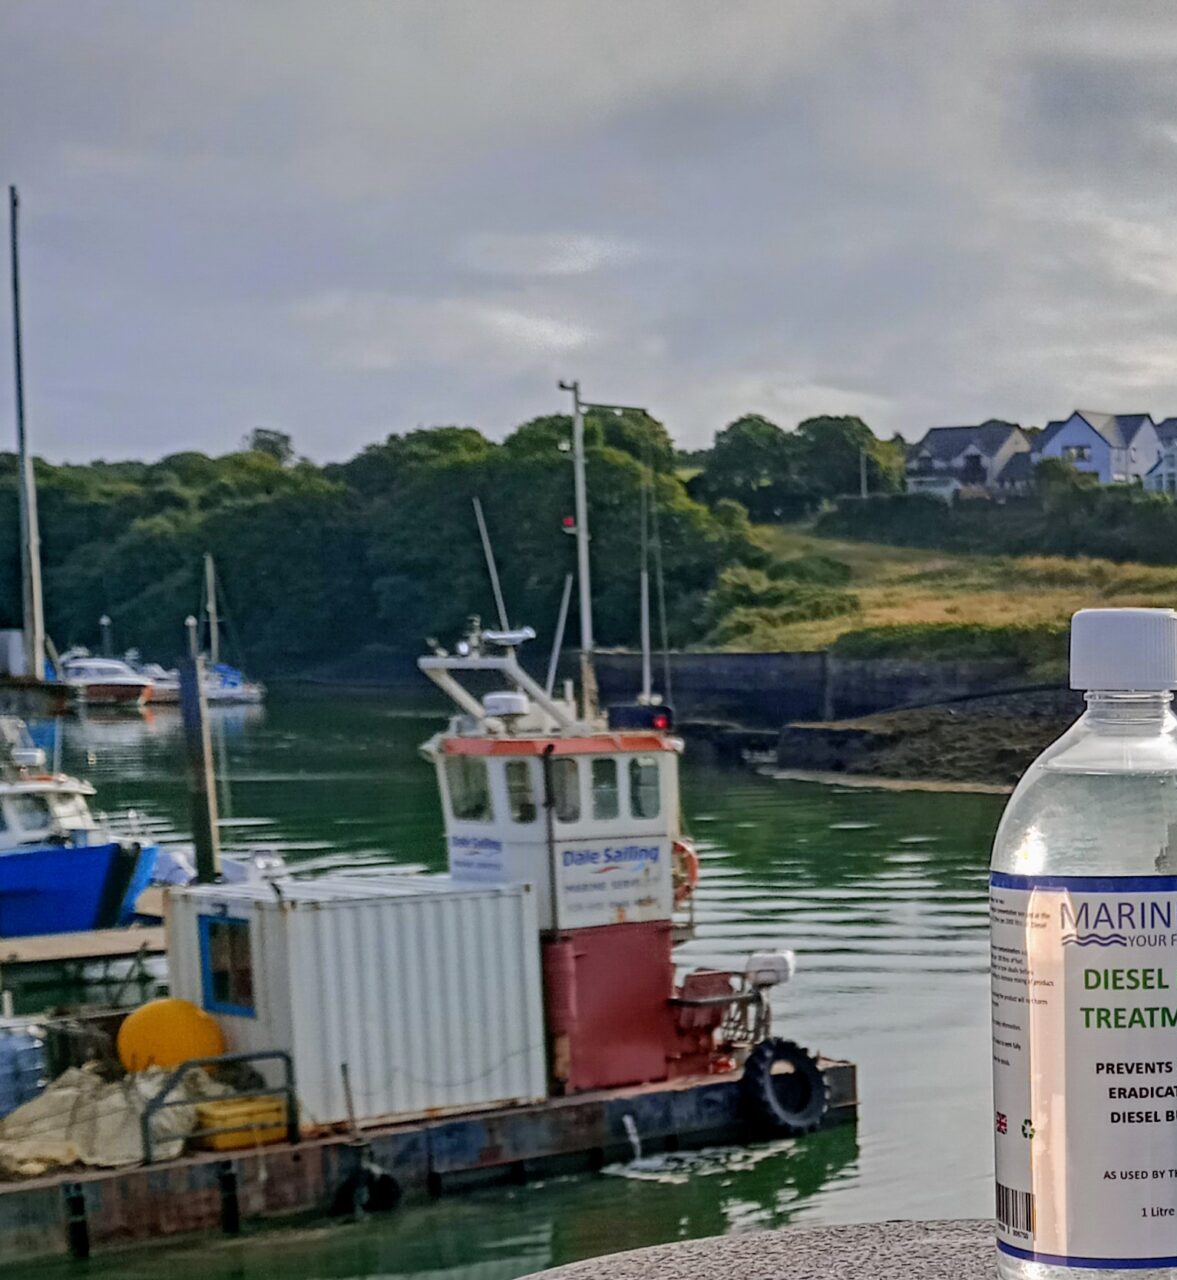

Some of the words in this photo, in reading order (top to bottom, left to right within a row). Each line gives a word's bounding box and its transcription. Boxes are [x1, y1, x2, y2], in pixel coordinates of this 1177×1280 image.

[563, 850, 600, 867] Dale
[604, 845, 660, 864] Sailing
[1129, 935, 1167, 948] YOUR
[1084, 967, 1170, 991] DIESEL
[1096, 1061, 1173, 1075] PREVENTS
[1110, 1111, 1161, 1124] DIESEL
[1103, 1170, 1117, 1180] AS
[1120, 1170, 1149, 1180] USED
[1152, 1170, 1166, 1179] BY
[1141, 1207, 1148, 1218] 1
[1151, 1206, 1175, 1217] Litre
